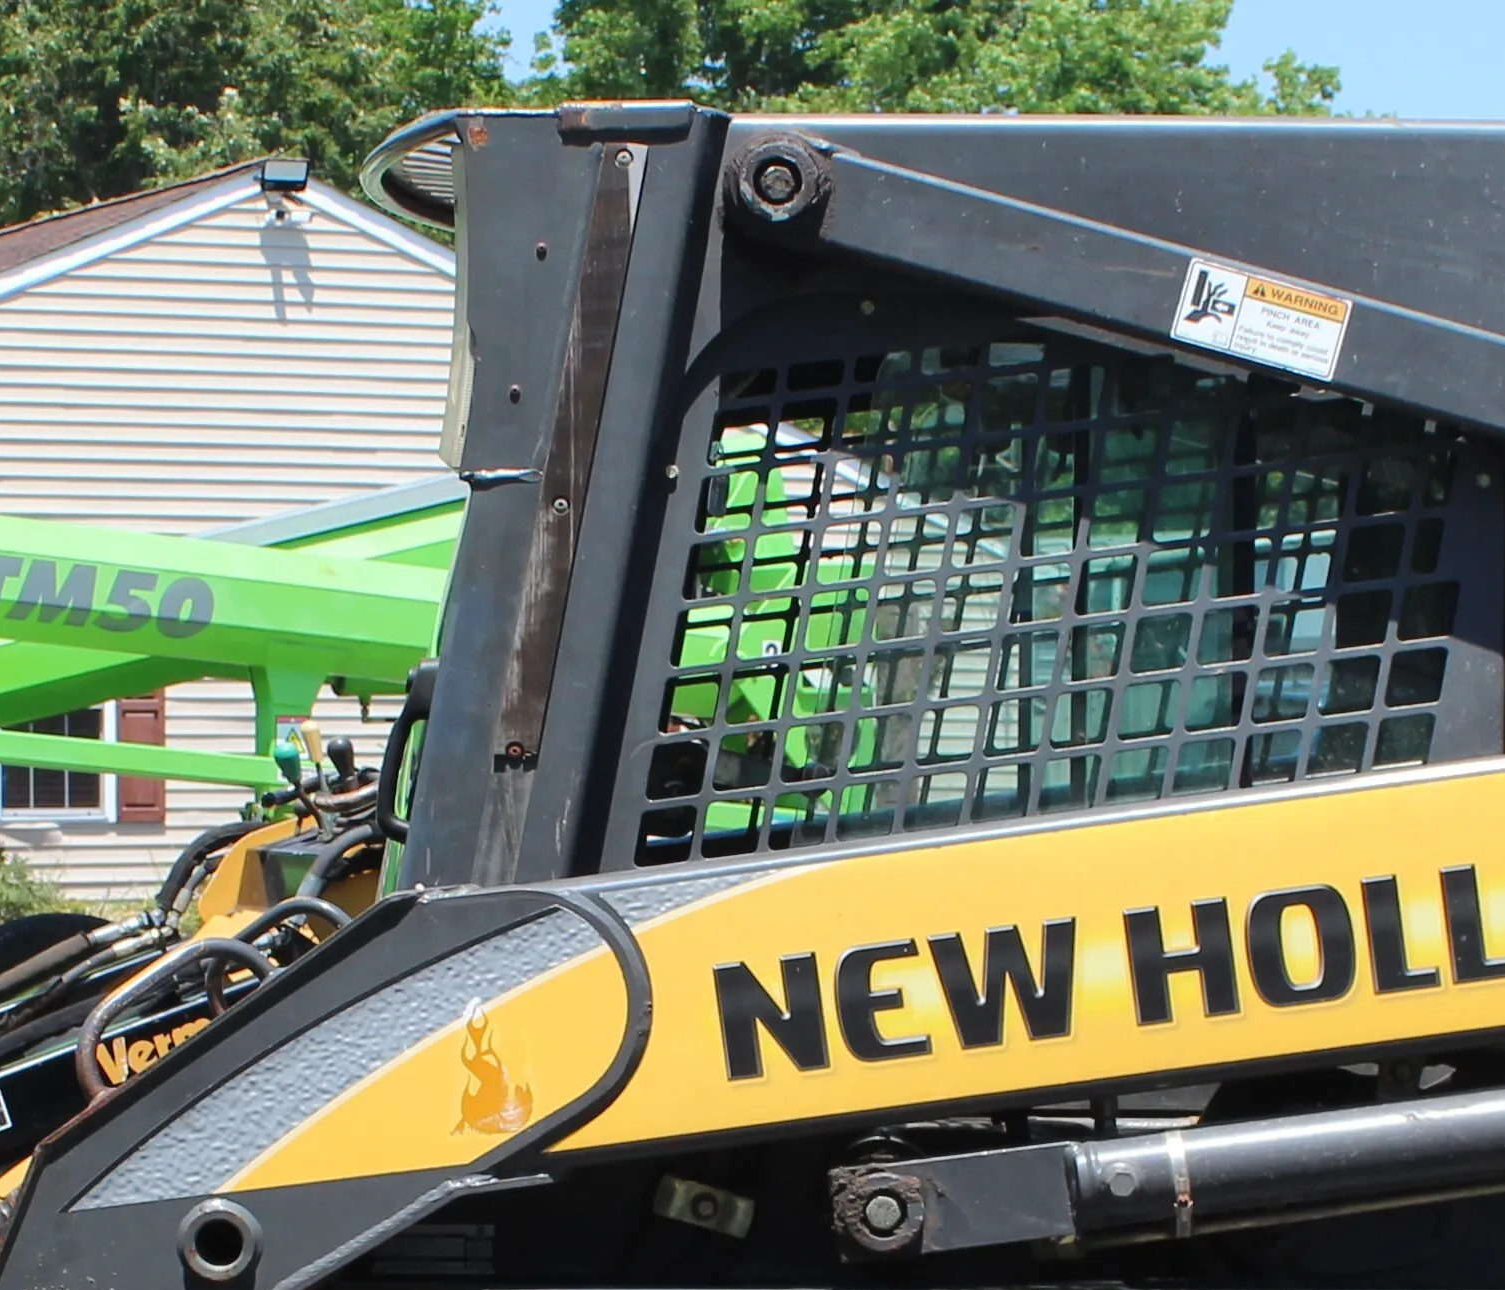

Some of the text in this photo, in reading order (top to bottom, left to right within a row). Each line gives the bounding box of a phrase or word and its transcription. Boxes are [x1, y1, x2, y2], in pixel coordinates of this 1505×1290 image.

[1271, 287, 1339, 316] WARNING
[1261, 306, 1320, 330] PINCH AREA
[712, 915, 1077, 1083] NEW
